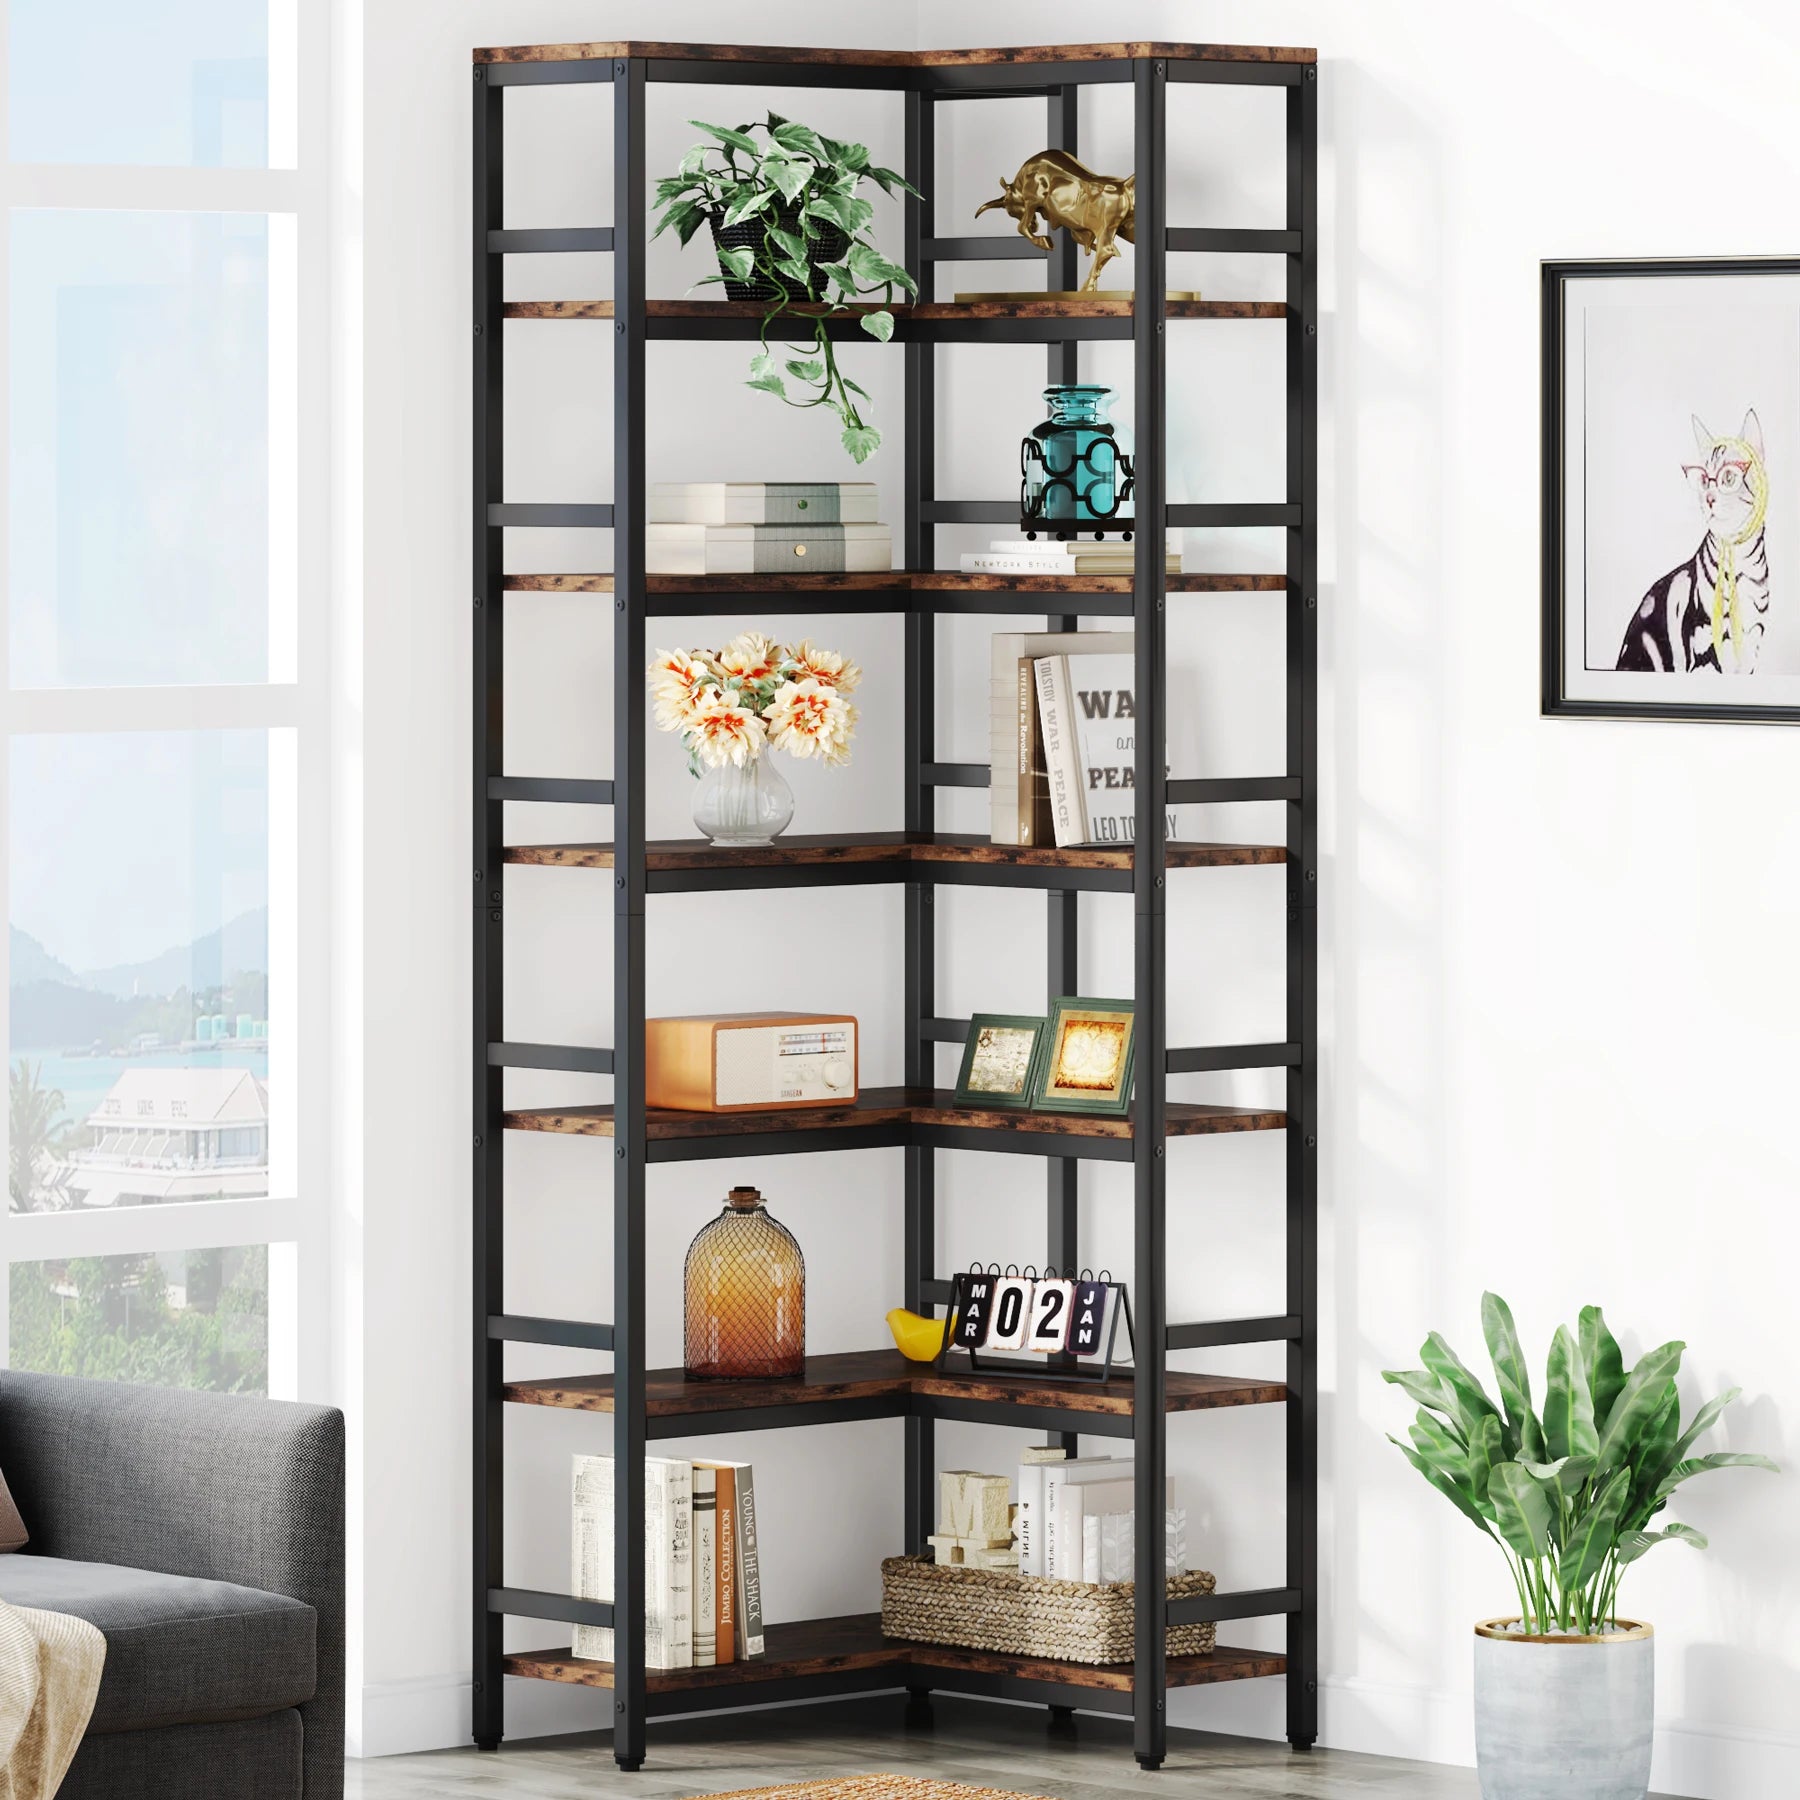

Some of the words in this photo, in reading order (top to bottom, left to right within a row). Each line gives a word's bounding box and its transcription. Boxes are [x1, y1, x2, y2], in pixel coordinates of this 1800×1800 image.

[1040, 661, 1055, 702] TOLSTOY
[1077, 690, 1136, 719] WA
[1020, 725, 1028, 774] Revolution
[1047, 708, 1060, 752] WAR
[1116, 736, 1136, 750] an
[1054, 769, 1069, 829] PEACE
[1093, 816, 1118, 841] LEO
[742, 1488, 755, 1535] YOUNG
[720, 1509, 730, 1582] COLLECTION
[744, 1547, 757, 1576] THE
[720, 1584, 732, 1625] JUMBO
[746, 1578, 761, 1622] SHACK
